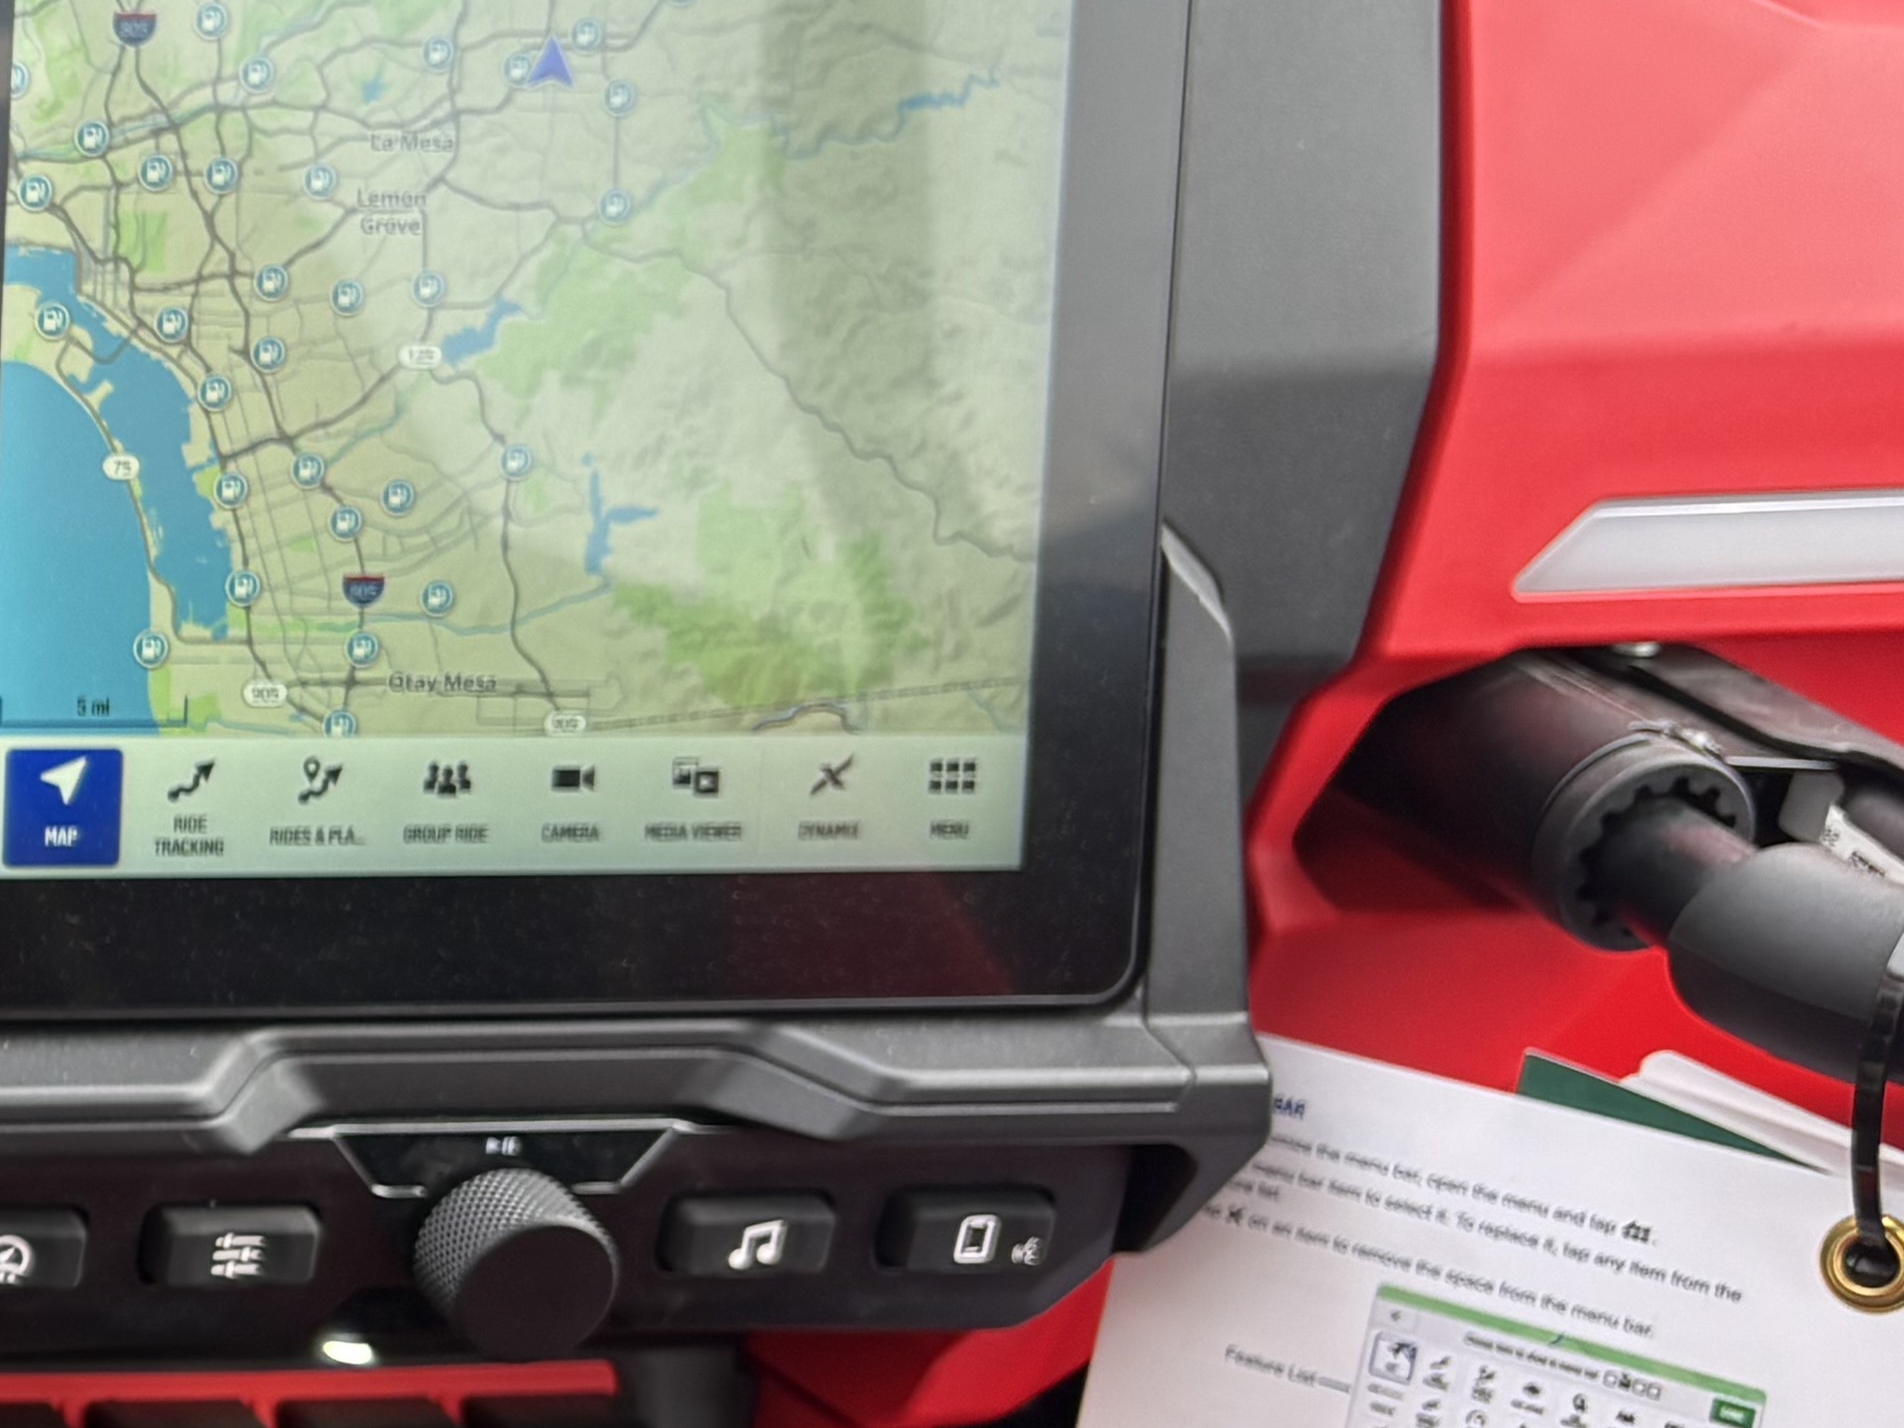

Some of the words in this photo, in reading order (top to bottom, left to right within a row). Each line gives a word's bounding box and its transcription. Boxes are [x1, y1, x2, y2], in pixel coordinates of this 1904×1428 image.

[371, 134, 395, 151] La
[401, 134, 454, 152] Mesa
[357, 189, 427, 208] Lemon
[360, 216, 422, 236] Grove
[389, 672, 437, 694] Otay
[443, 673, 497, 693] Mesa
[173, 814, 208, 834] RIDE
[403, 824, 451, 844] GROUP
[455, 824, 488, 843] RIDE
[541, 822, 600, 842] CAMERA
[645, 822, 688, 841] MEDIA
[693, 822, 742, 841] VIEWER
[930, 821, 970, 839] MENU
[44, 826, 79, 847] MAP
[270, 826, 310, 846] RIDES
[155, 838, 224, 858] TRACKING
[1551, 1208, 1586, 1227] and
[1562, 1241, 1590, 1262] tap
[1593, 1253, 1625, 1272] any
[1628, 1260, 1666, 1282] item
[1670, 1270, 1710, 1294] from
[1714, 1282, 1742, 1302] the
[1540, 1294, 1567, 1314] the
[1570, 1304, 1619, 1328] menu
